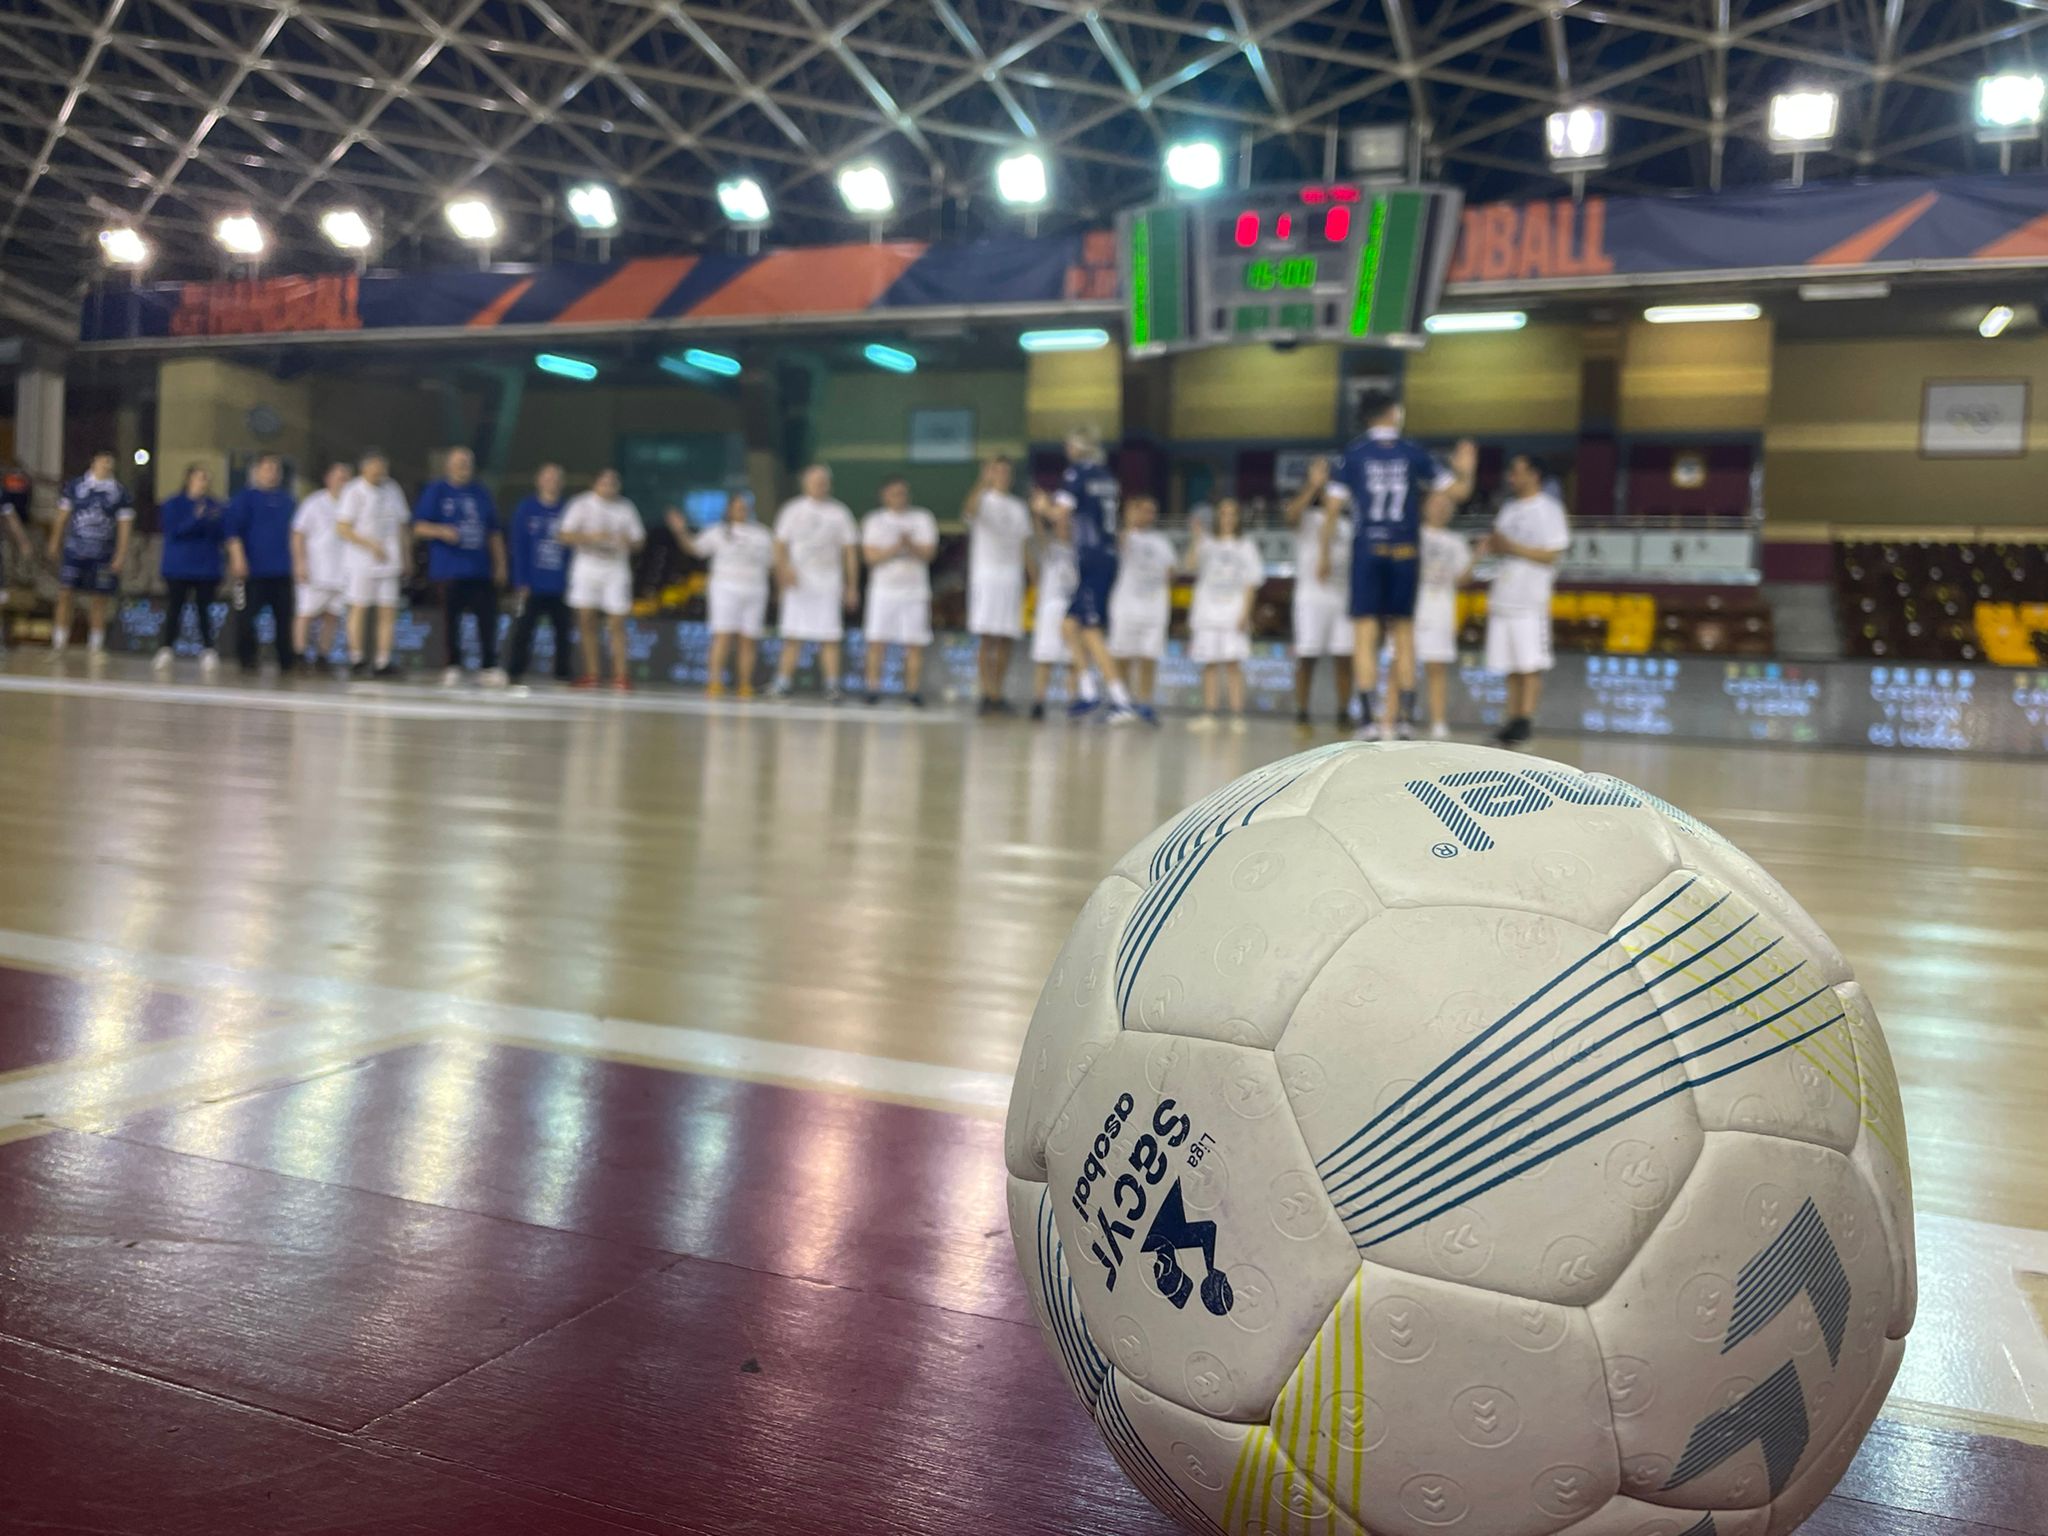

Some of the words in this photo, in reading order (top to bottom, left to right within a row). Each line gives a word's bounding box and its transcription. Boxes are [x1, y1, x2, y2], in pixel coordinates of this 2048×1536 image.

[1366, 477, 1410, 523] 77
[1072, 1092, 1135, 1223] asobal
[1186, 1132, 1216, 1168] Liga
[1091, 1098, 1191, 1293] sacyr
